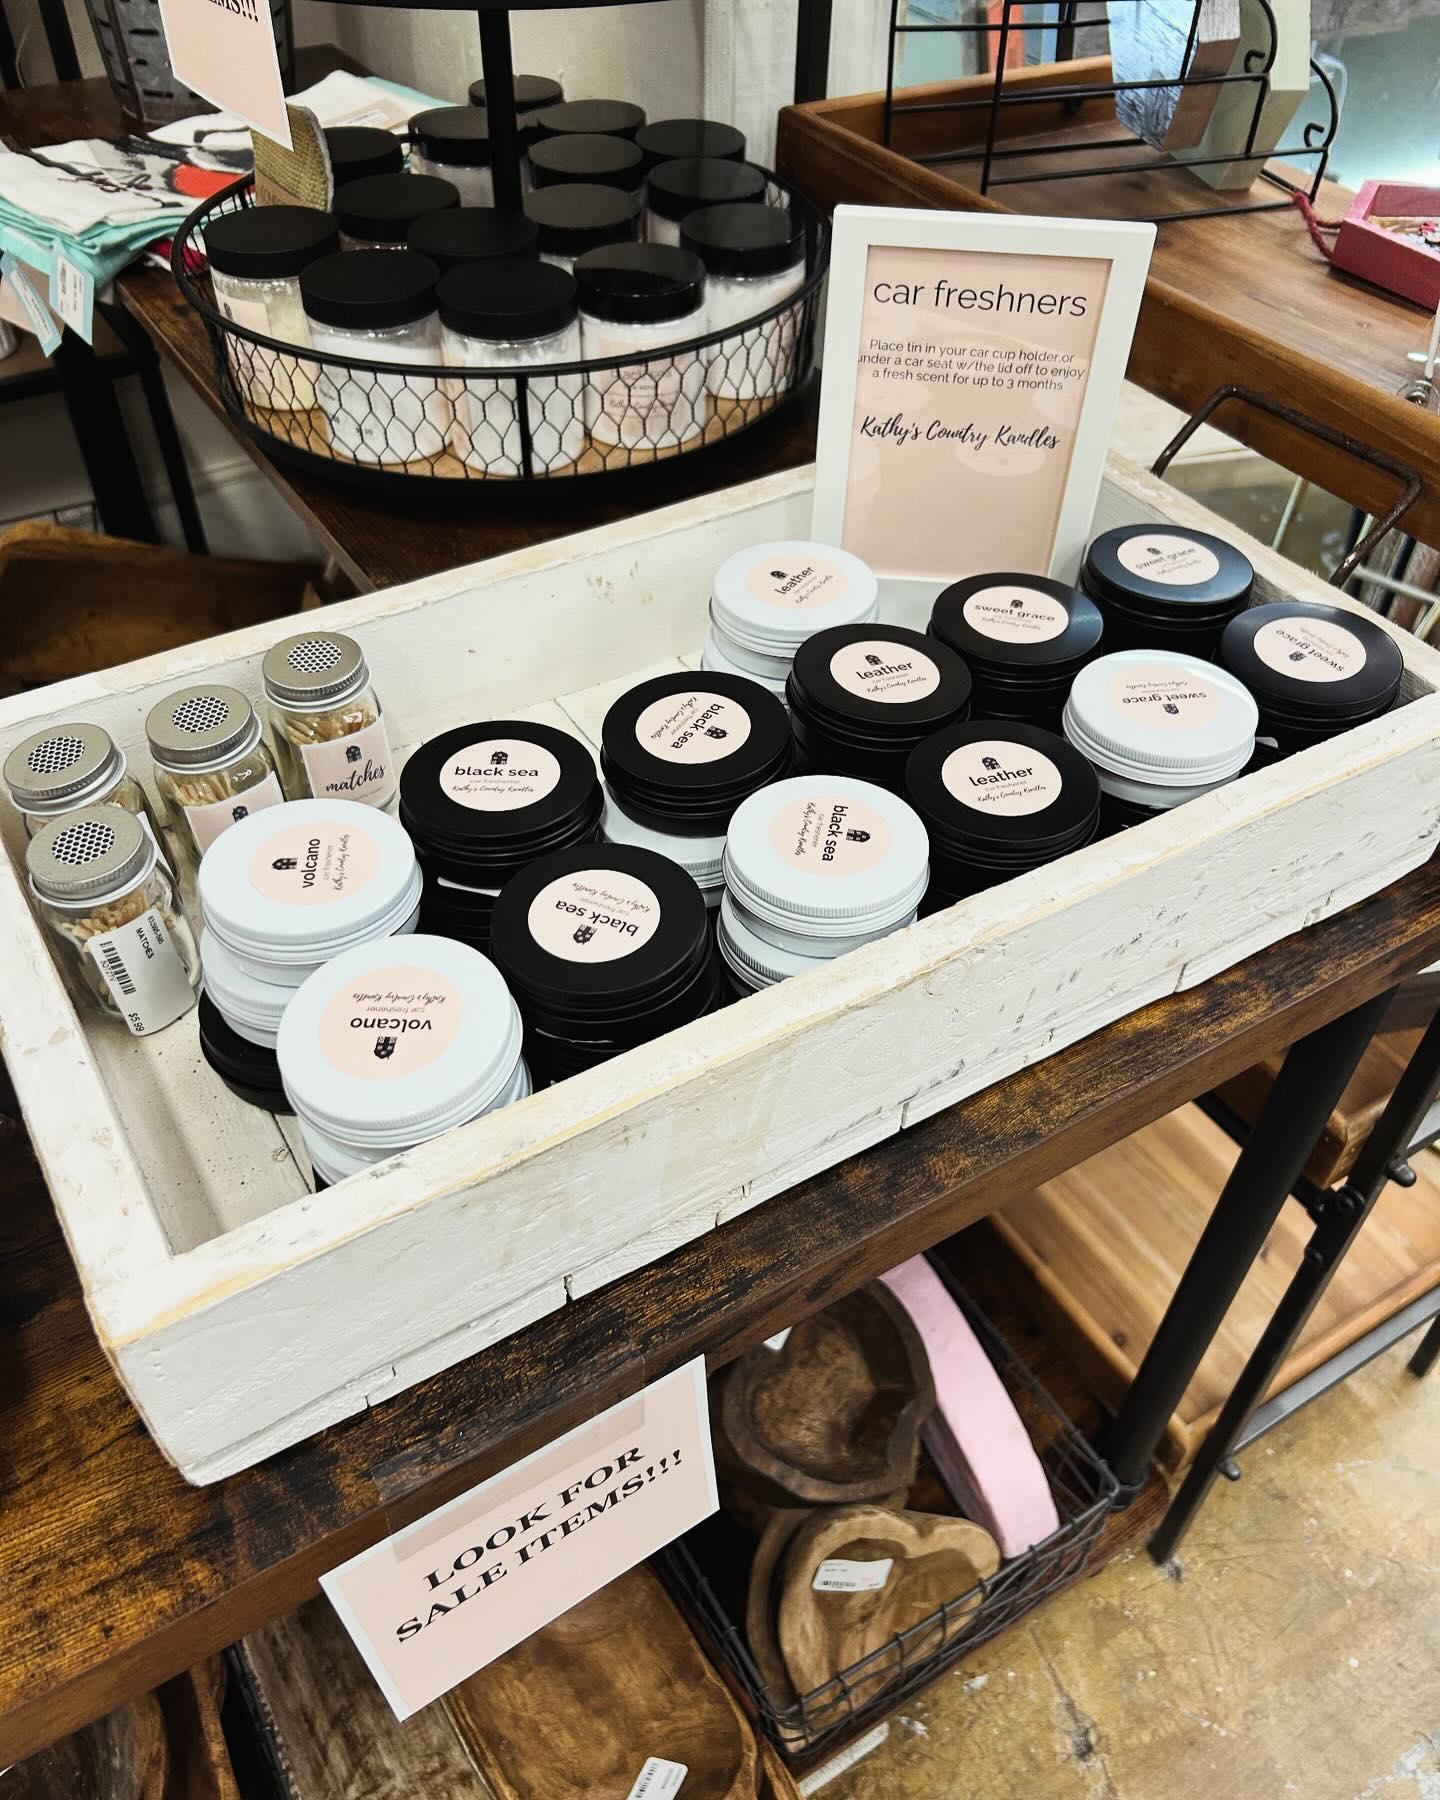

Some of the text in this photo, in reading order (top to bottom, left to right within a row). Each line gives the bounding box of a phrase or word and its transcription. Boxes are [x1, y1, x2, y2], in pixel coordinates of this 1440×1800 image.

[873, 280, 1087, 317] car freshners
[870, 339, 904, 352] Place
[907, 342, 922, 352] tin
[926, 342, 936, 354] in
[940, 346, 966, 358] your
[970, 348, 989, 358] car
[992, 350, 1016, 362] cup
[872, 368, 1063, 390] a fresh scent for up to 3 months
[894, 357, 902, 366] a
[904, 358, 923, 367] car
[927, 359, 952, 369] seat
[956, 360, 995, 372] w/the
[998, 362, 1013, 374] lid
[1016, 363, 1033, 375] off
[1036, 366, 1048, 376] to
[1050, 366, 1086, 380] enjoy
[860, 412, 1060, 451] Kathy's Country Kandles
[774, 566, 815, 594] leather
[974, 604, 1056, 622] sweet grace
[856, 662, 913, 680] leather
[1308, 649, 1345, 672] sweet
[1122, 692, 1207, 704] sweet grace
[689, 703, 725, 732] black
[670, 730, 694, 749] sea
[326, 759, 385, 792] matches
[454, 766, 539, 777] black sea
[968, 767, 1033, 787] leather
[821, 804, 849, 862] black sea
[300, 838, 321, 889] volcano
[555, 900, 587, 917] sea
[588, 911, 640, 937] black
[136, 927, 155, 960] MATCHES
[350, 1017, 433, 1033] volcano
[422, 1447, 646, 1593] LOOK FOR
[396, 1449, 683, 1643] SALE ITEMS!!!
